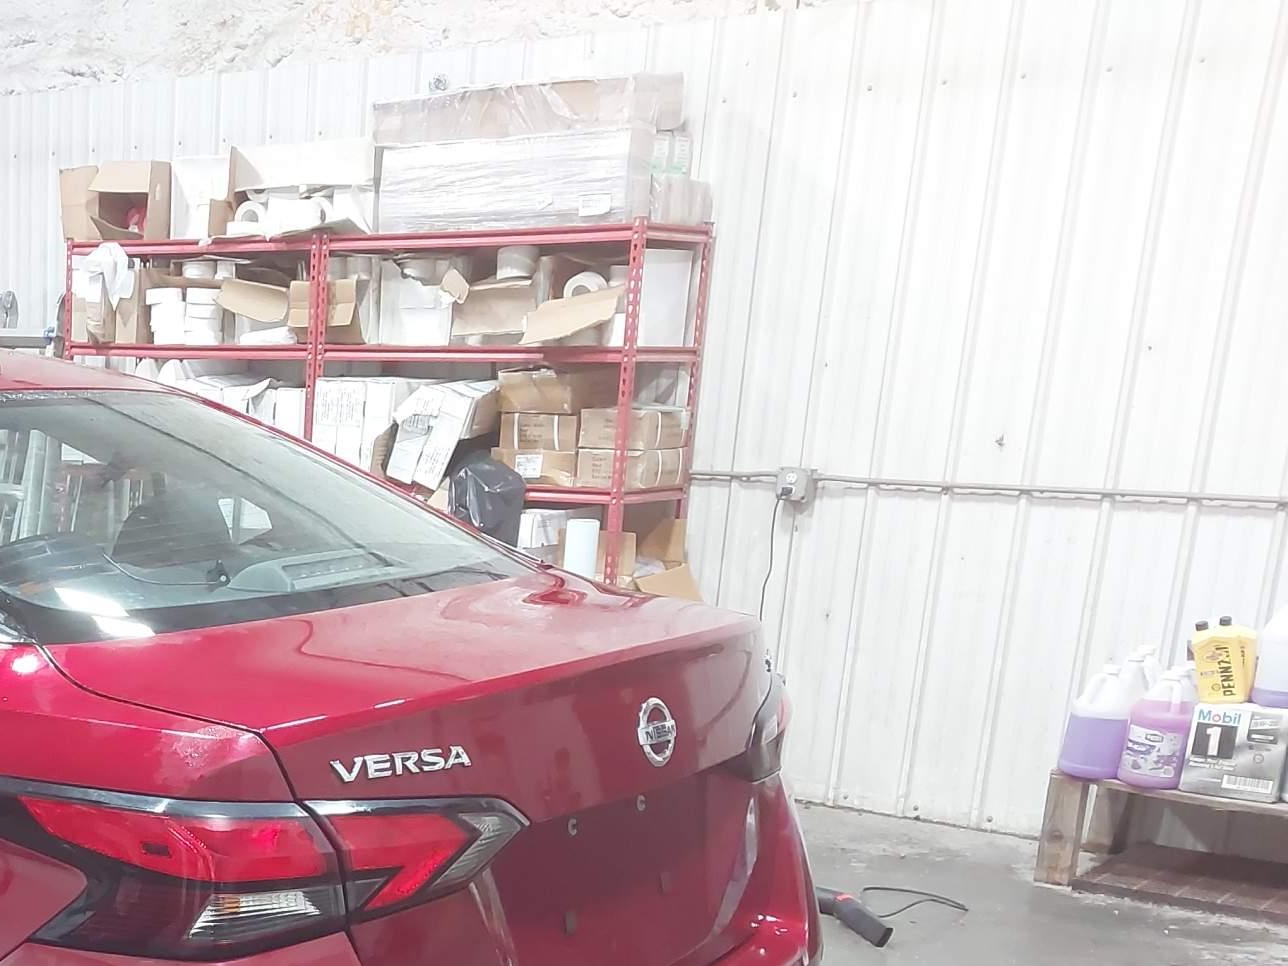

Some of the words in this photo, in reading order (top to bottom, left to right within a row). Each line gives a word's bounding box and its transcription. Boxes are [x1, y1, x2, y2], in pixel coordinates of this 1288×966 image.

[1214, 645, 1237, 697] PENNZI
[1198, 709, 1242, 725] Mobil
[1206, 726, 1222, 756] 1
[329, 745, 472, 783] VERSA
